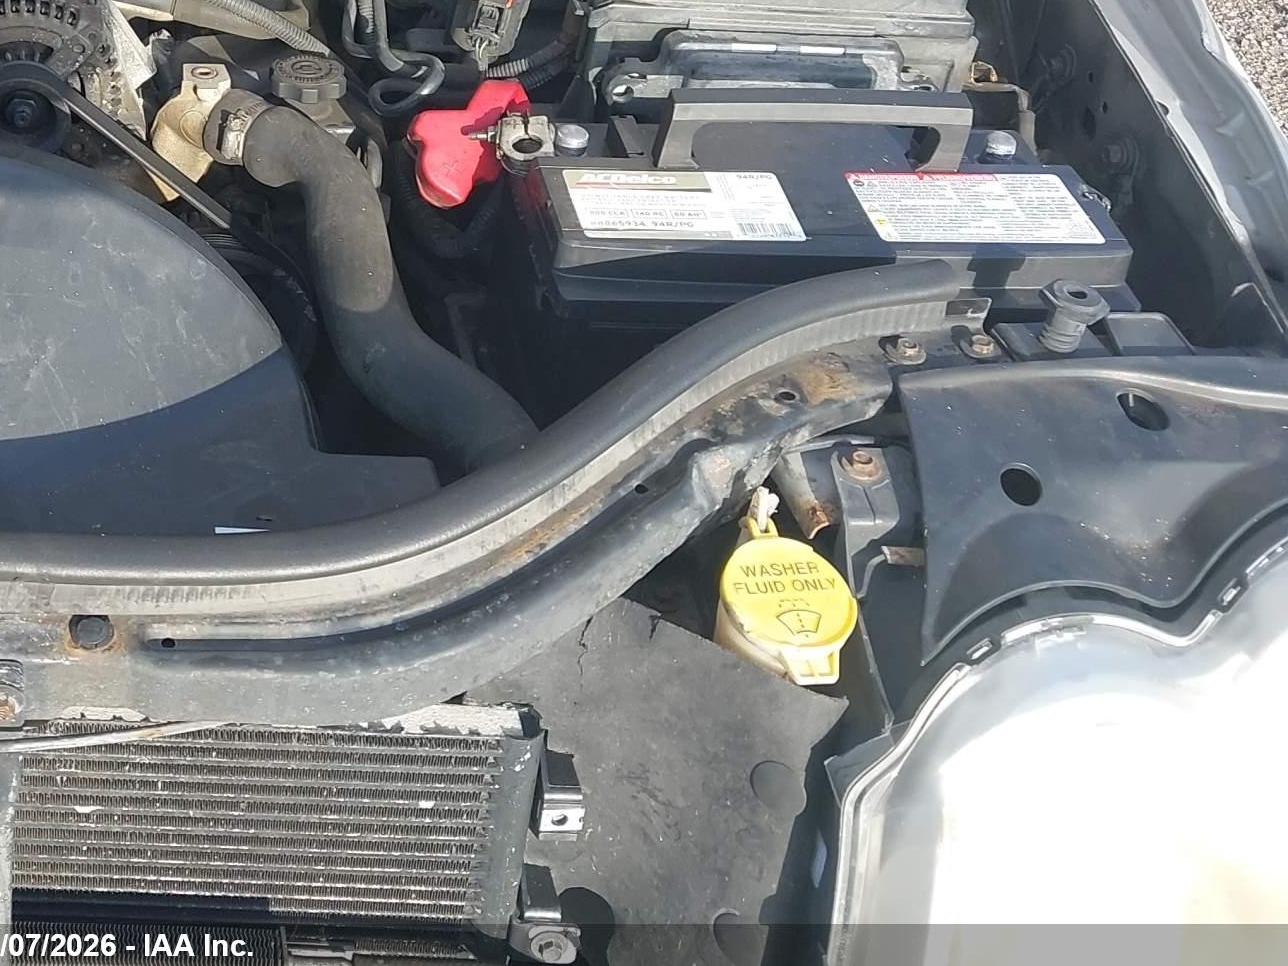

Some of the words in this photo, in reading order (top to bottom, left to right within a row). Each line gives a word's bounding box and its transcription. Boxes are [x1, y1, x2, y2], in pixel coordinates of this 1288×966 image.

[578, 173, 677, 185] ACDelco
[739, 561, 820, 578] WASHER
[733, 581, 786, 595] FLUID
[791, 577, 836, 593] ONLY
